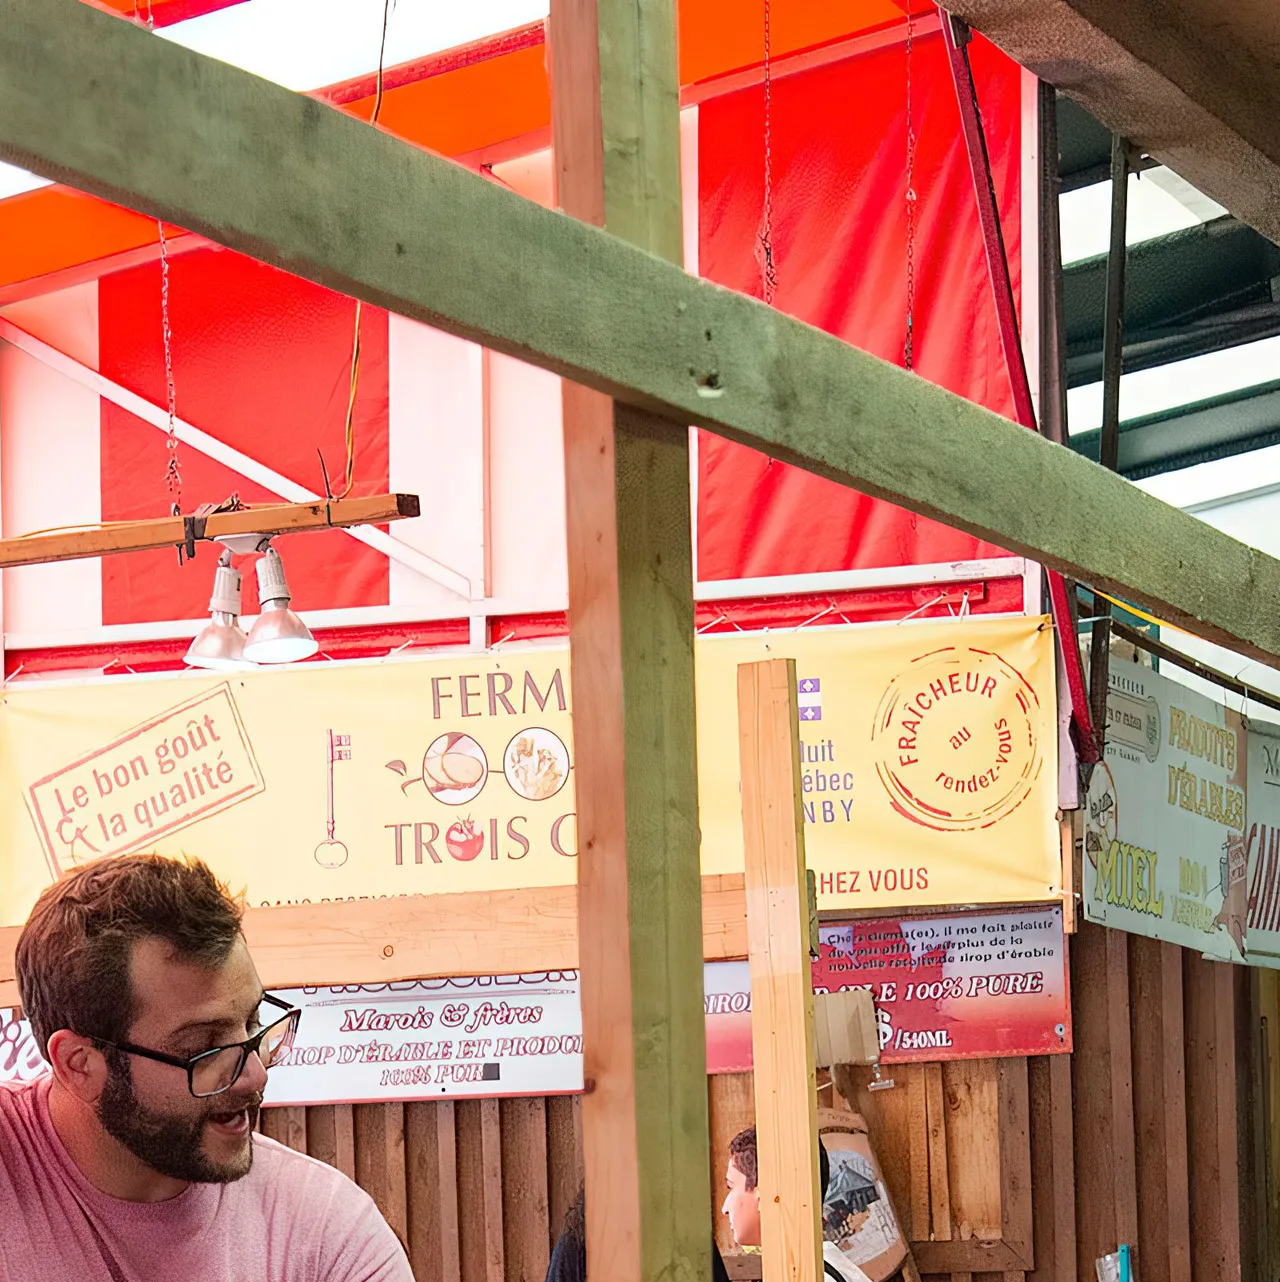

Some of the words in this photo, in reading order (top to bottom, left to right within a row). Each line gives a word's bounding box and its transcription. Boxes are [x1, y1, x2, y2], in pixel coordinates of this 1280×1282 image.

[431, 668, 567, 719] FERM
[898, 672, 997, 767] FRAÎCHEUR
[949, 726, 971, 750] au
[55, 785, 89, 816] Le
[93, 755, 149, 798] bon
[155, 714, 221, 775] goût
[936, 718, 1012, 793] rendez-vous
[97, 813, 127, 841] la
[134, 750, 233, 828] qualité
[820, 871, 861, 894] HEZ
[869, 867, 928, 892] VOUS
[1094, 839, 1165, 918] MIEL
[905, 976, 962, 1001] 100%
[968, 972, 1043, 997] PURE
[340, 1006, 434, 1032] Marois
[440, 1003, 469, 1028] &
[465, 1001, 543, 1033] frères
[337, 1039, 453, 1065] D'ÉRABLE
[456, 1038, 491, 1060] ET
[380, 1063, 431, 1086] 100%
